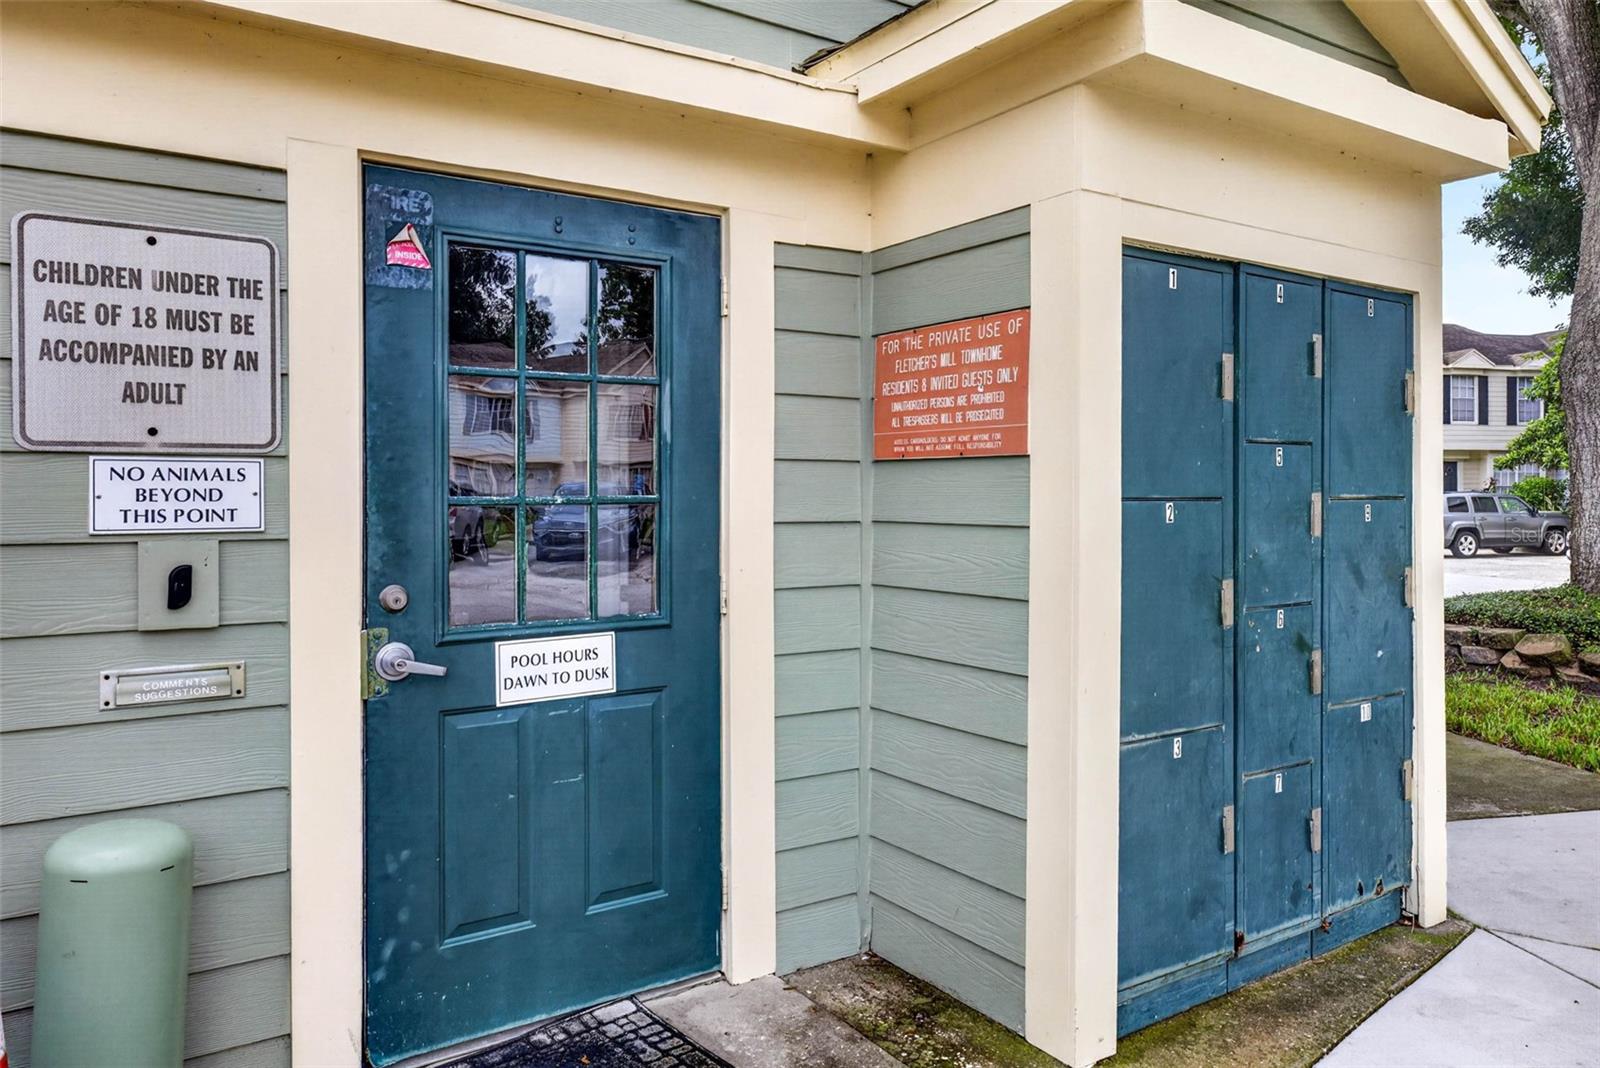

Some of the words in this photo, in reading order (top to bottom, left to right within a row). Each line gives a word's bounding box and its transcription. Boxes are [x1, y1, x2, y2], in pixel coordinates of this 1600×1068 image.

[33, 259, 142, 290] CHILDREN
[151, 270, 219, 296] UNDER
[226, 276, 263, 300] THE
[43, 300, 86, 324] AGE
[95, 303, 122, 326] OF
[132, 306, 157, 328] 18
[166, 308, 222, 333] MUST
[230, 314, 255, 336] BE
[882, 339, 900, 354] FOR
[904, 335, 924, 351] THE
[928, 326, 972, 348] PRIVATE
[978, 321, 1001, 339] USE
[1008, 317, 1024, 334] OF
[38, 338, 193, 368] ACCOMPANIED
[202, 348, 228, 370] BY
[234, 350, 258, 372] AN
[895, 354, 938, 374] FLETCHER'S
[940, 352, 957, 368] MILL
[961, 344, 1004, 364] TOWNHOME
[882, 379, 918, 396] RESIDENTS
[930, 374, 958, 391] INVITED
[962, 370, 993, 388] GUESTS
[996, 367, 1019, 384] ONLY
[121, 381, 186, 405] ADULT
[930, 396, 954, 408] PERSONS
[956, 394, 968, 406] ARE
[970, 390, 1005, 404] PROHIBITED
[892, 416, 900, 428] ALL
[940, 412, 953, 424] WILL
[956, 411, 963, 423] BE
[110, 466, 145, 482] NO
[151, 467, 246, 482] ANIMALS
[135, 488, 224, 502] BEYOND
[120, 509, 166, 524] THIS
[174, 508, 238, 523] POINT
[511, 653, 548, 668] POOL
[553, 648, 598, 664] HOURS
[142, 678, 208, 690] COMMENTS
[504, 674, 548, 690] DAWN
[552, 671, 570, 684] TO
[575, 667, 609, 682] DUSK
[134, 686, 218, 700] SUGGESTIONS
